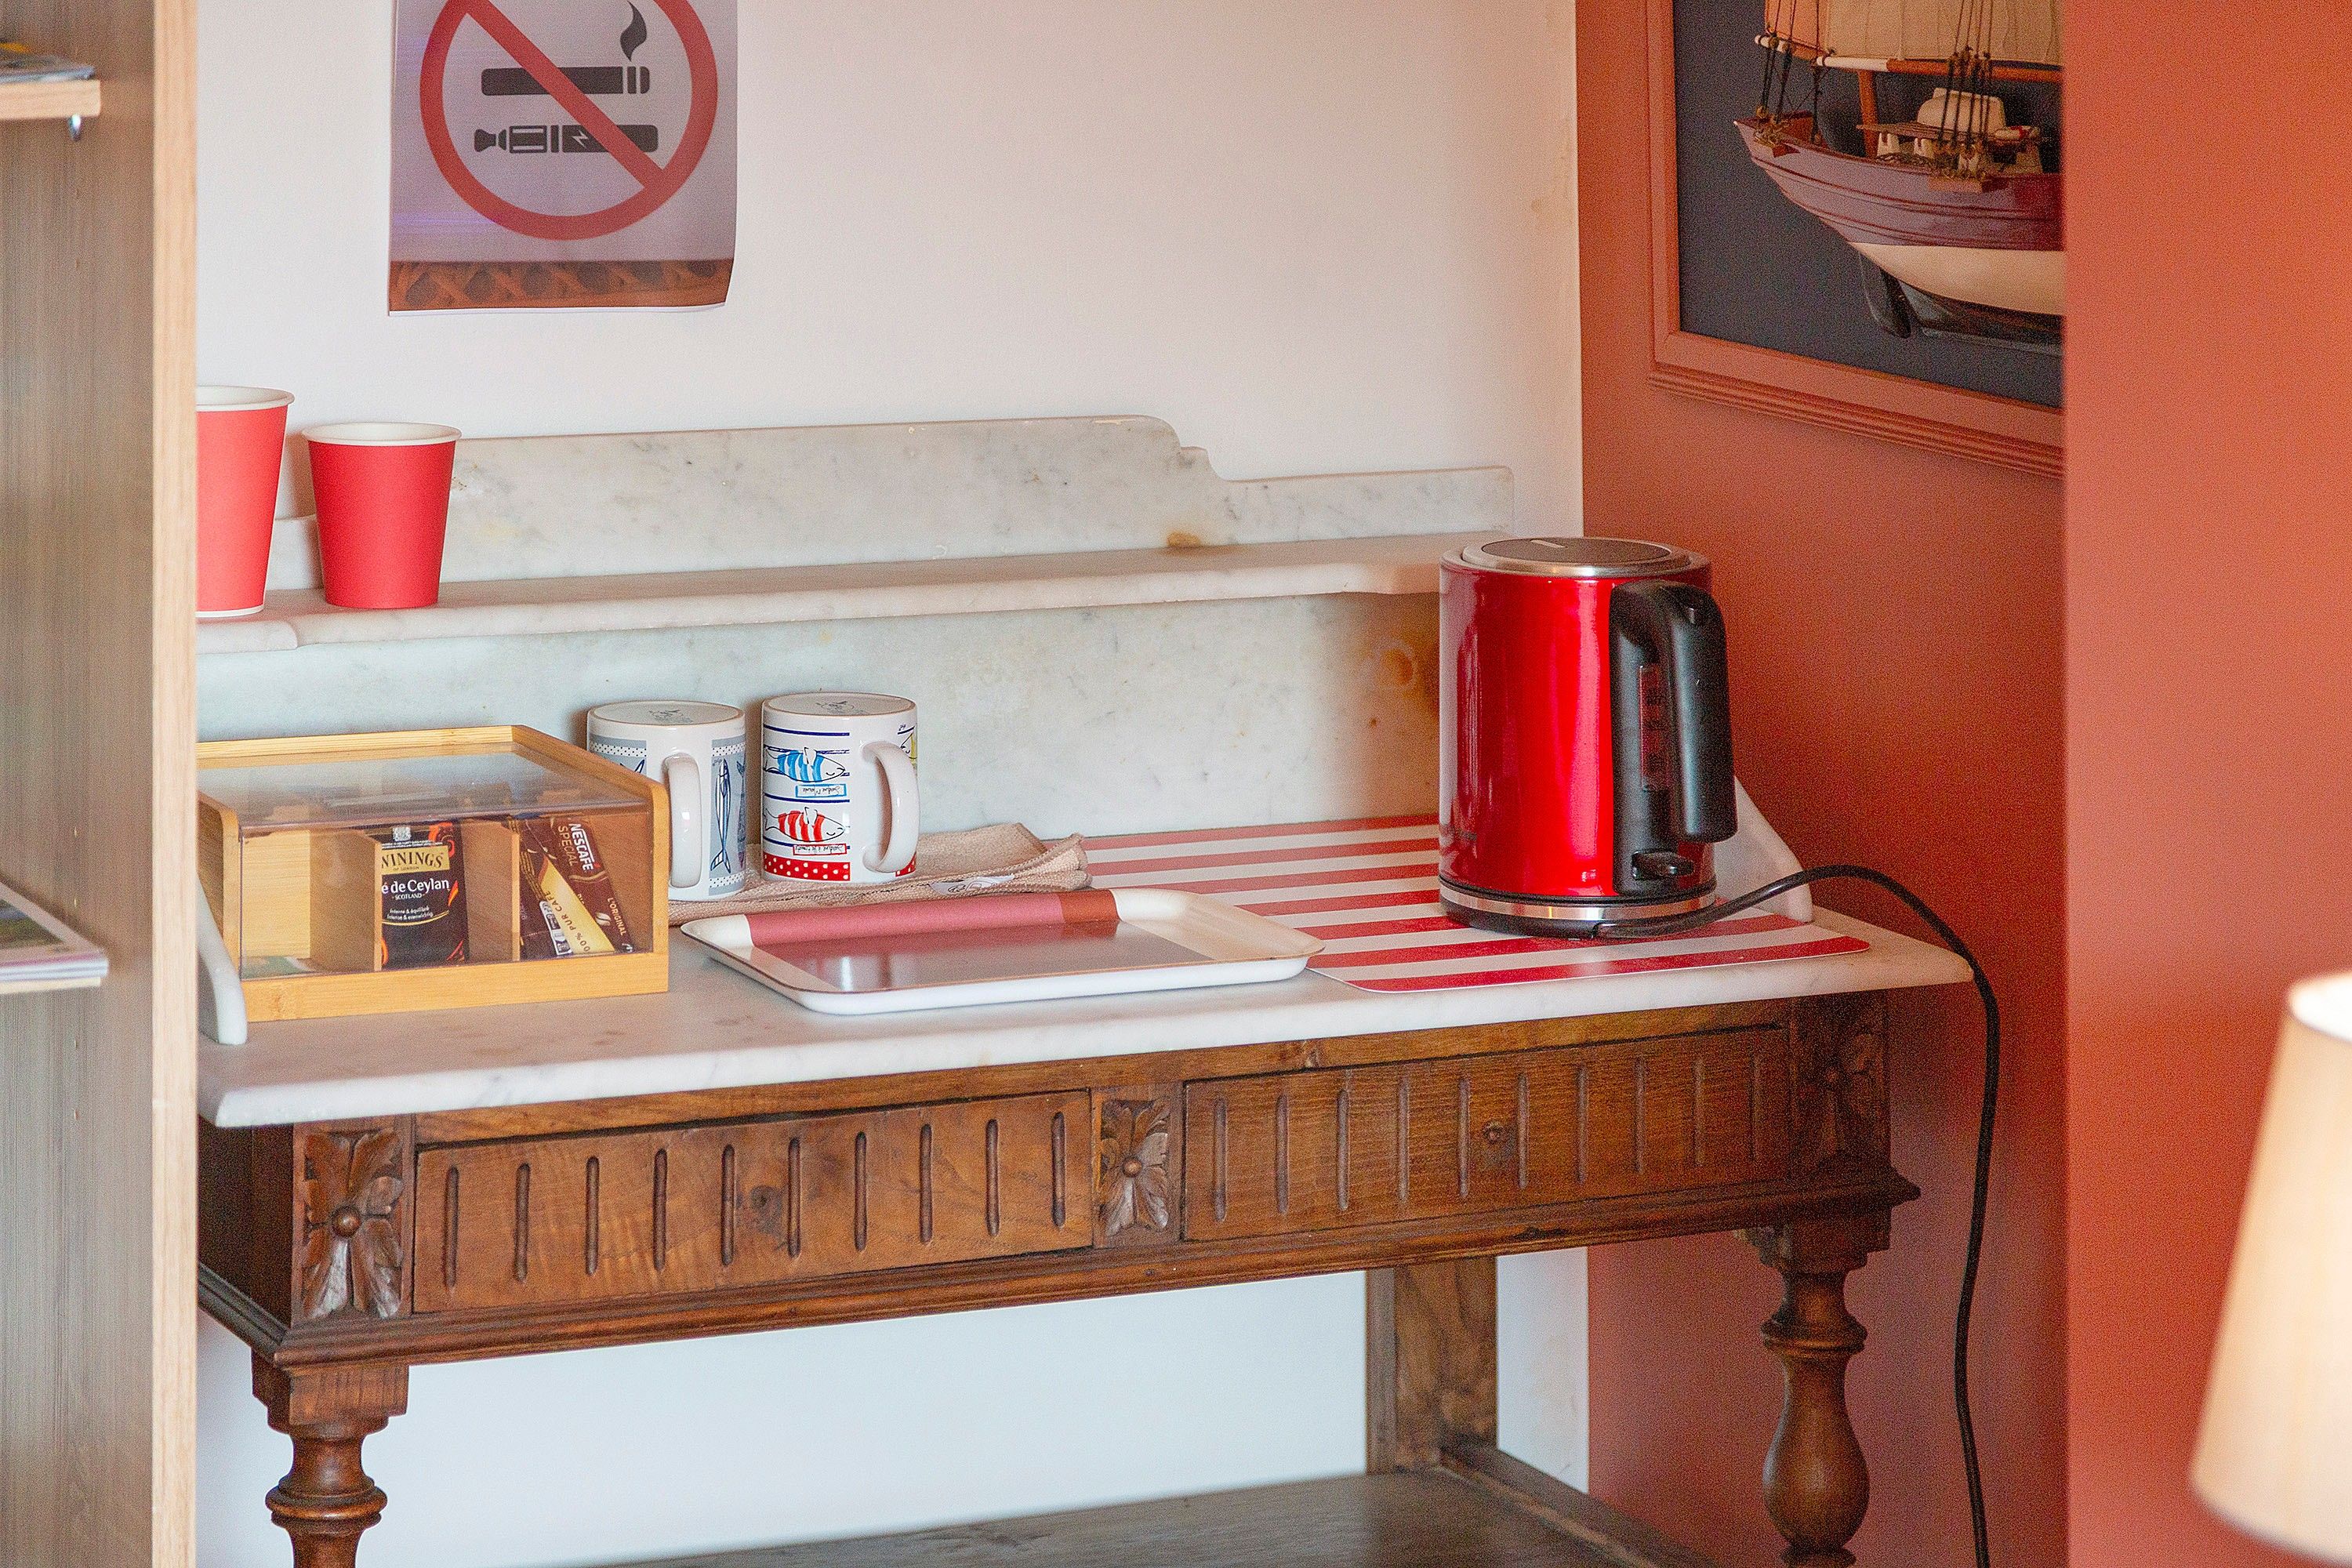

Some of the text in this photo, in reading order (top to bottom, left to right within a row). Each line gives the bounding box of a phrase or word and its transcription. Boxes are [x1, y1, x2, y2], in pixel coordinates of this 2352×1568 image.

[390, 880, 406, 893] de
[408, 878, 449, 894] Ceylan
[561, 914, 576, 931] PUR
[607, 897, 627, 936] L'ORIGINAL
[576, 932, 590, 952] 00%
